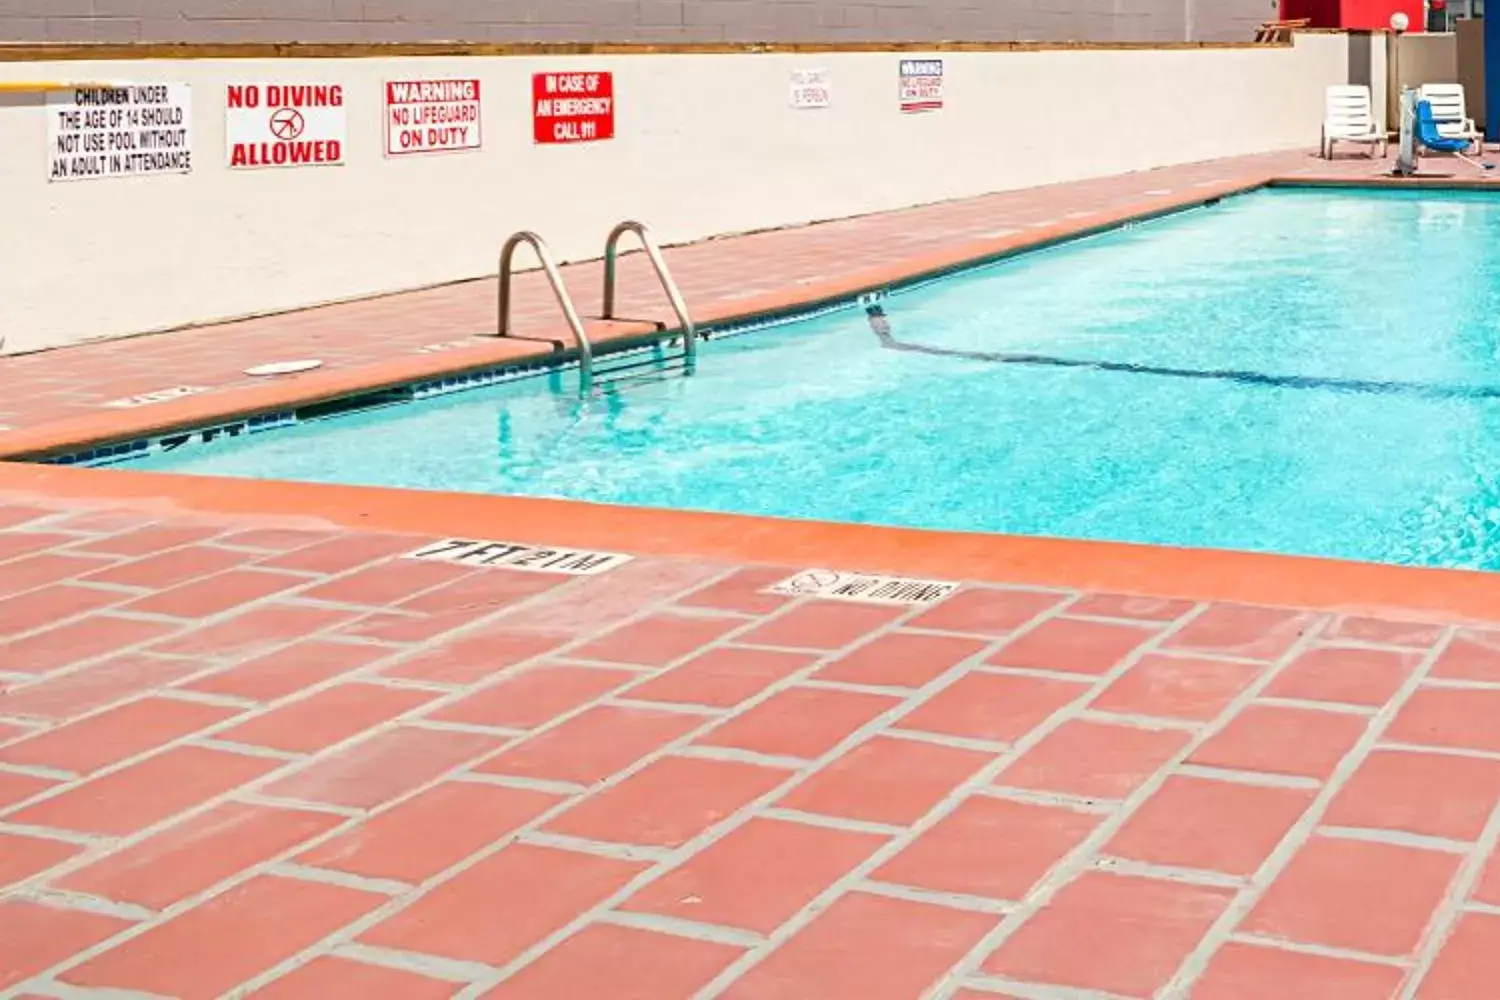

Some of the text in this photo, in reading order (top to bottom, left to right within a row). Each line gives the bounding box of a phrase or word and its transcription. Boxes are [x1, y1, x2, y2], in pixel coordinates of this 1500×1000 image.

[392, 81, 474, 103] WARNING
[545, 73, 600, 93] IN CASE OF
[75, 85, 168, 106] CHILDREN UNDER
[227, 85, 343, 108] NO DIVING
[553, 97, 611, 116] EMERGENCY
[58, 107, 182, 130] THE AGE OF 14 SHOULD
[392, 104, 477, 126] NO LIFEGUARD
[400, 127, 469, 148] ON DUTY
[553, 119, 597, 140] CALL 911
[57, 129, 187, 153] NOT USE POOL WITHOUT
[52, 151, 190, 178] AN ADULT IN ATTENDANCE
[231, 140, 341, 167] ALLOWED
[415, 541, 478, 557] 7
[454, 543, 532, 565] FT
[832, 578, 954, 601] NO DIVING
